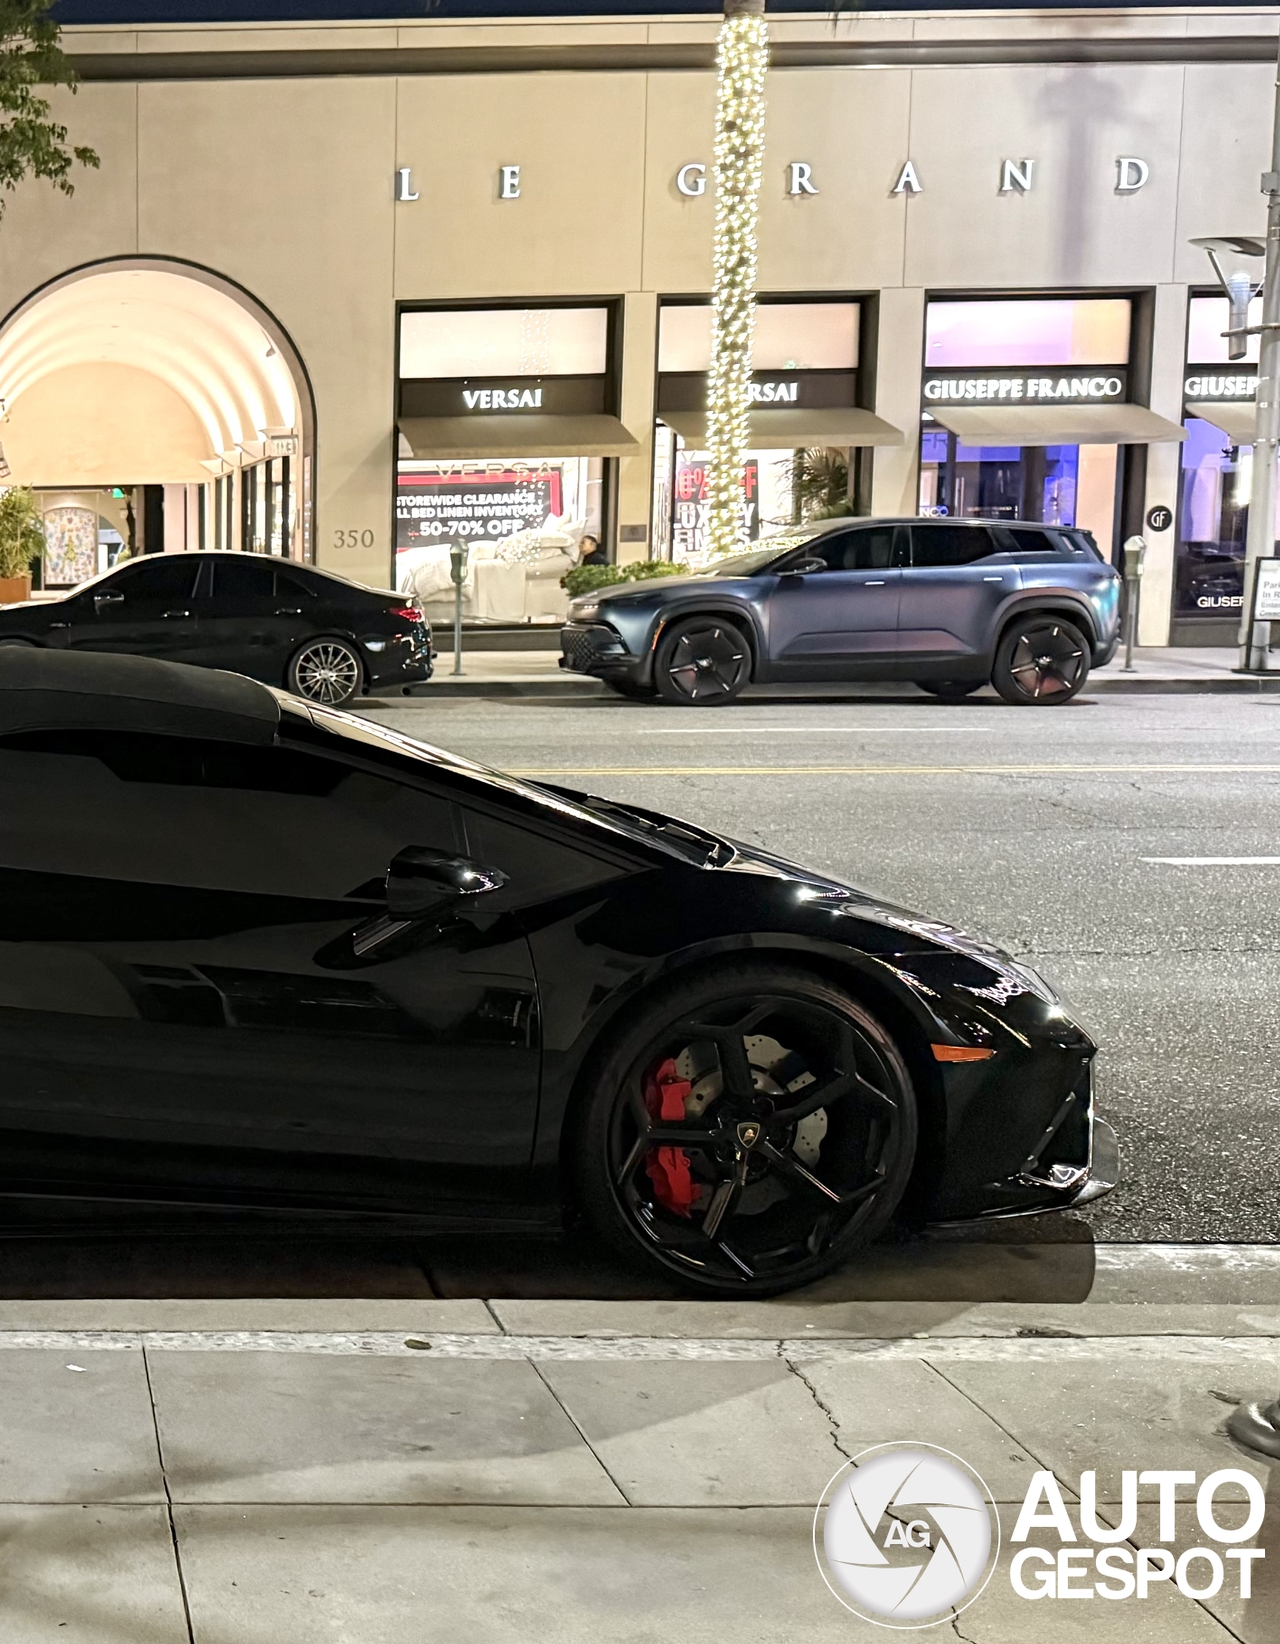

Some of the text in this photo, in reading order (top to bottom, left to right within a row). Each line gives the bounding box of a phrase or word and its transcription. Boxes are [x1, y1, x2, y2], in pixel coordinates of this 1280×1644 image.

[399, 158, 1149, 200] LE GRAND
[747, 382, 798, 402] RSAI
[924, 377, 1122, 399] GIUSEPPE FRANCO
[1184, 375, 1261, 396] GIUSEP
[462, 388, 542, 409] VERSAI
[462, 492, 536, 506] CLEARANCE
[397, 504, 544, 519] LL BED LINEN INVENTORY
[419, 519, 525, 537] 50-70% OFF
[333, 529, 374, 549] 350
